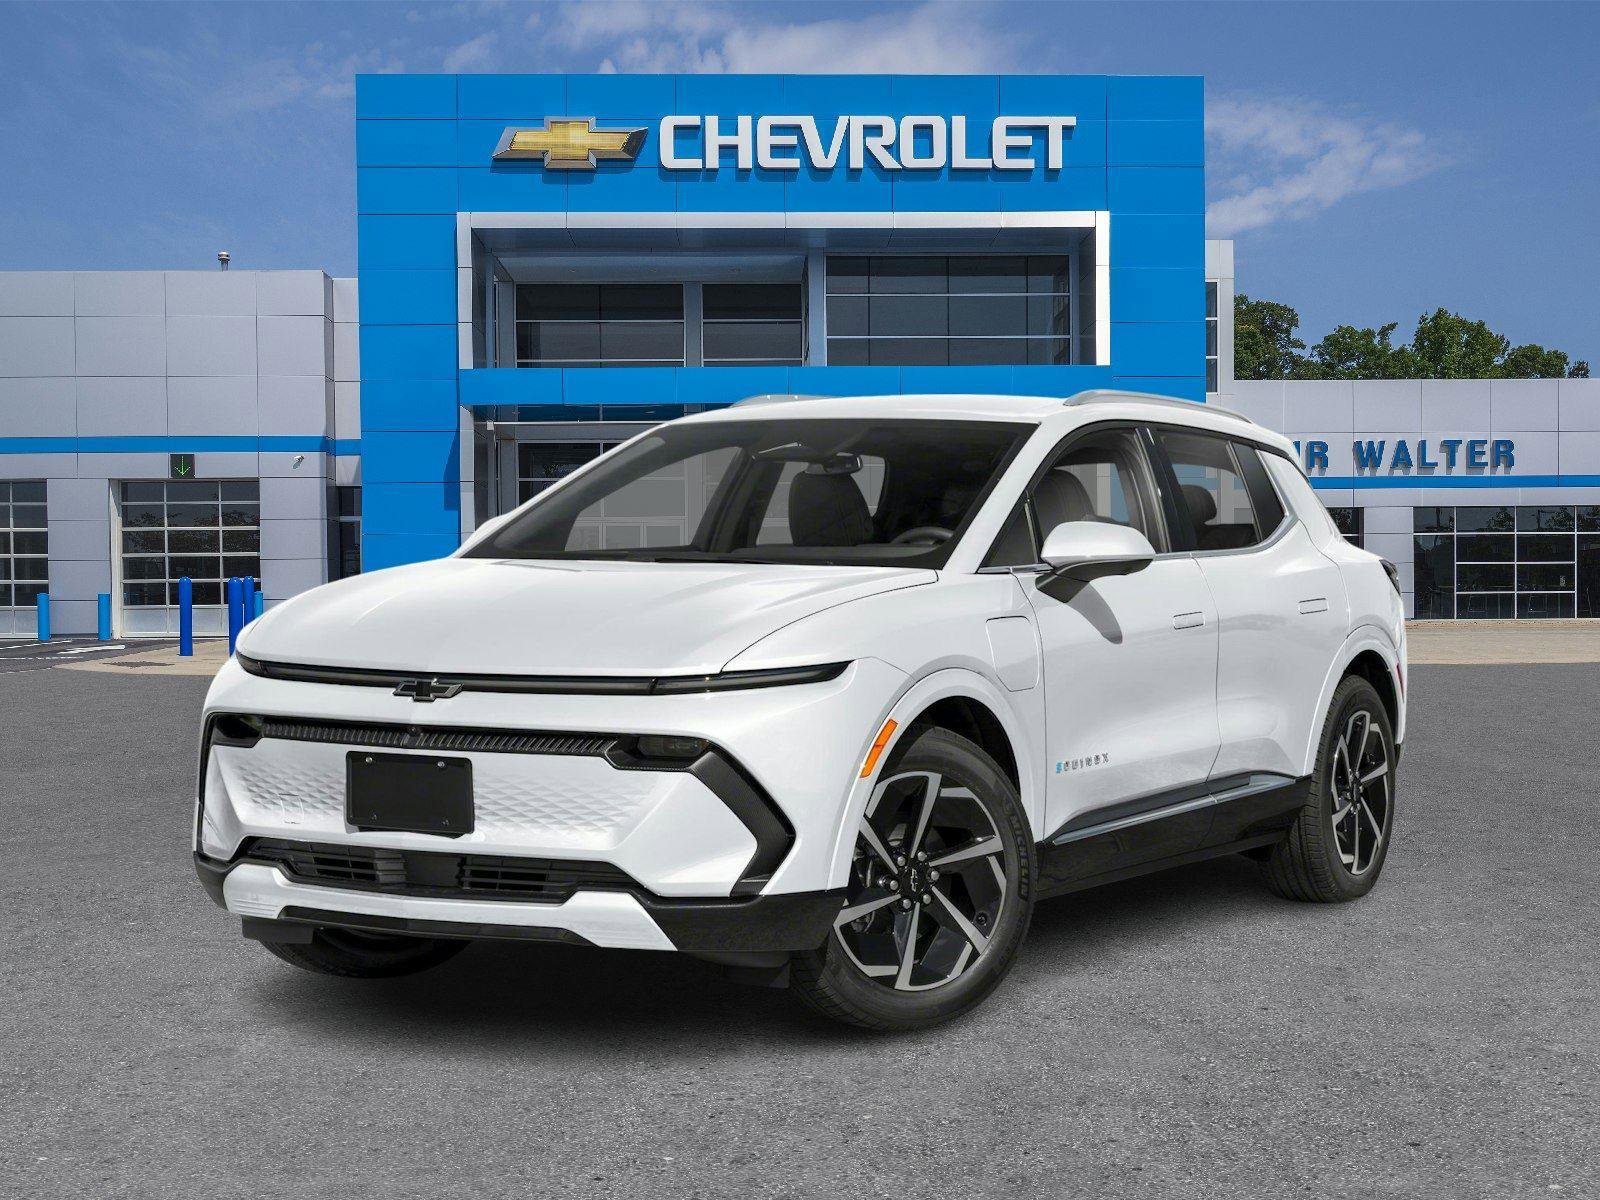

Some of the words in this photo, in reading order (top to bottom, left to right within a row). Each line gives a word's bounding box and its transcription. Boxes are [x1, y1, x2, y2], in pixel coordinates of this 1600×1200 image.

[659, 115, 1077, 169] CHEVROLET
[1293, 440, 1329, 469] R
[1354, 439, 1515, 469] WALTER
[1055, 752, 1109, 774] EQUINOX
